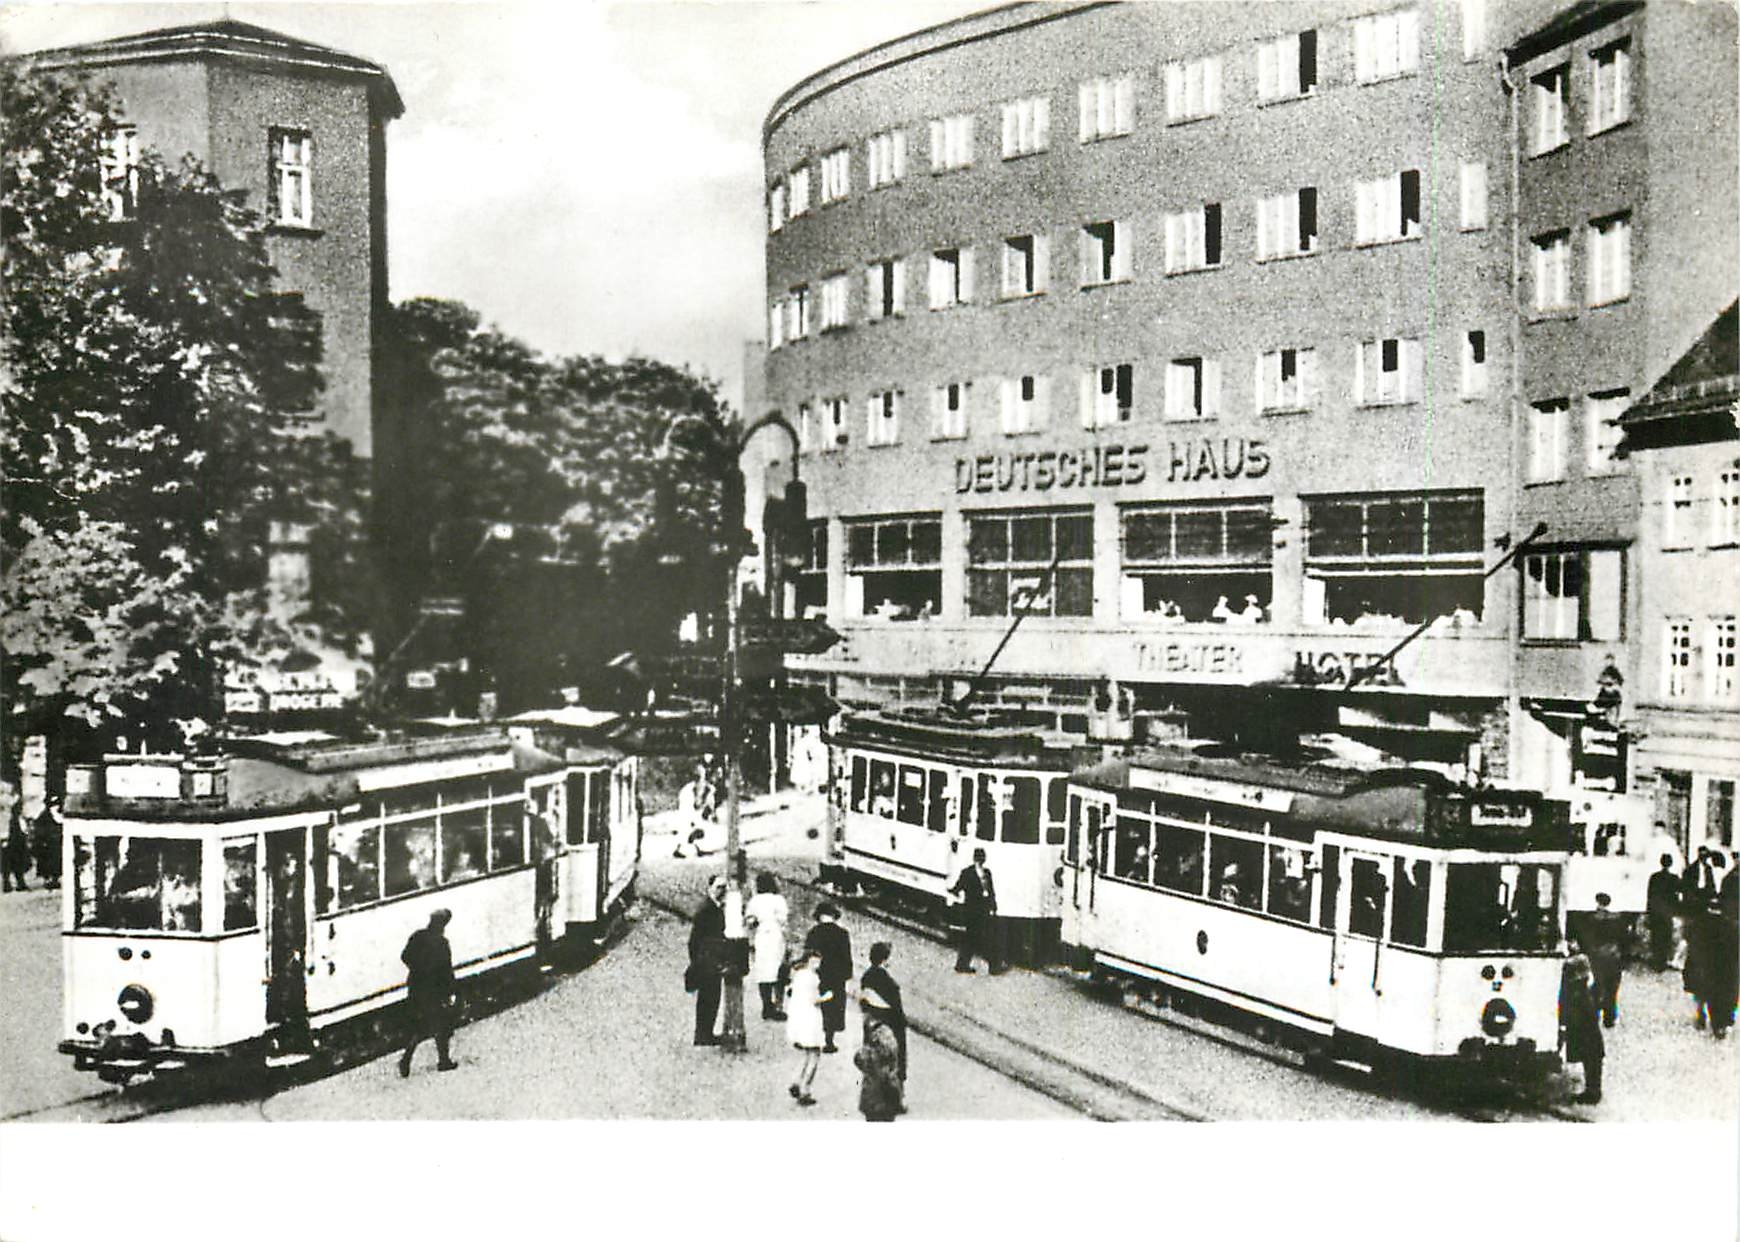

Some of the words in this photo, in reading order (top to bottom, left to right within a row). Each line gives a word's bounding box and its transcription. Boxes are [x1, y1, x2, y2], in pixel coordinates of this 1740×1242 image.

[956, 445, 1149, 494] DEUTSCHES
[1168, 439, 1271, 482] HAUS
[1134, 643, 1242, 674] THEATER
[1294, 651, 1406, 687] HOTEL
